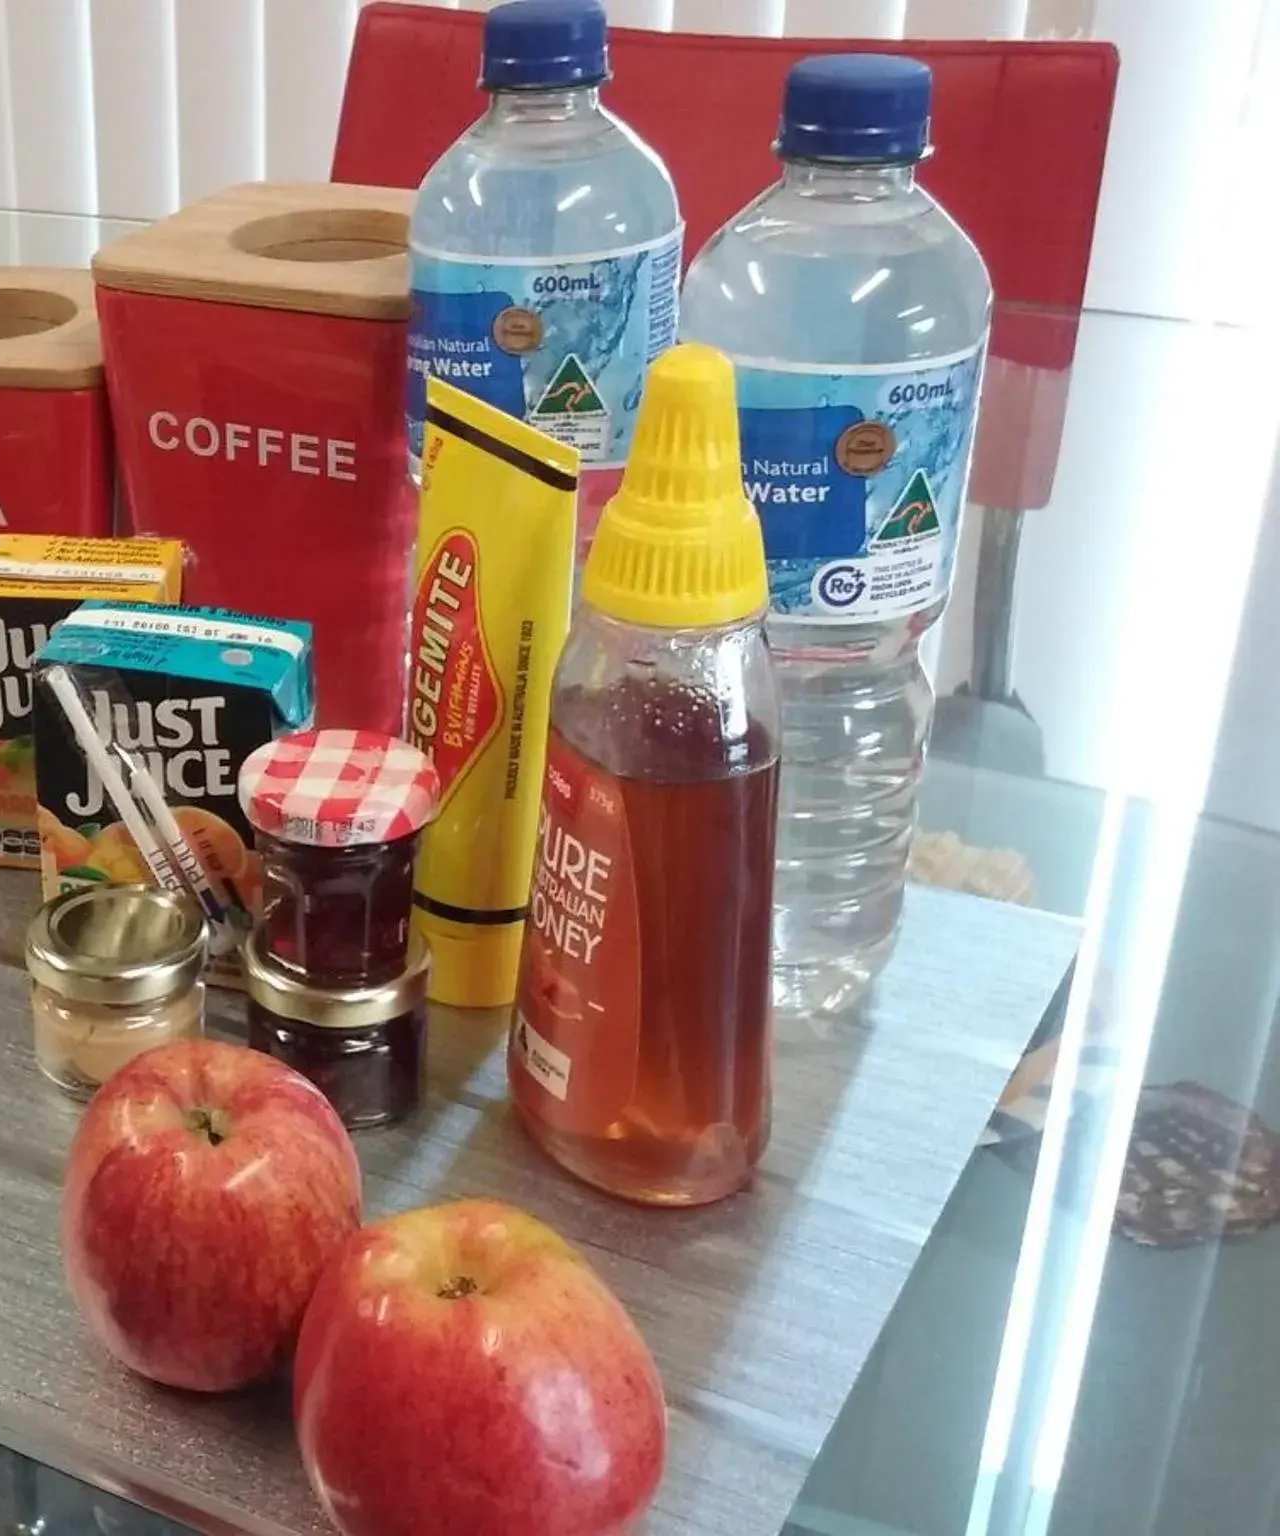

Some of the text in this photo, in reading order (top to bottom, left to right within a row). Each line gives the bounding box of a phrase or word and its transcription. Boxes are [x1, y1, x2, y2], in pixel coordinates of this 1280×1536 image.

[532, 274, 600, 294] 600mL
[438, 336, 490, 353] Natural
[433, 357, 492, 377] Water
[888, 380, 954, 405] 600mL
[147, 410, 358, 482] COFFEE
[753, 455, 829, 476] Natural
[744, 481, 831, 503] Water
[410, 550, 472, 766] EGEMITE
[532, 890, 603, 965] ONEY
